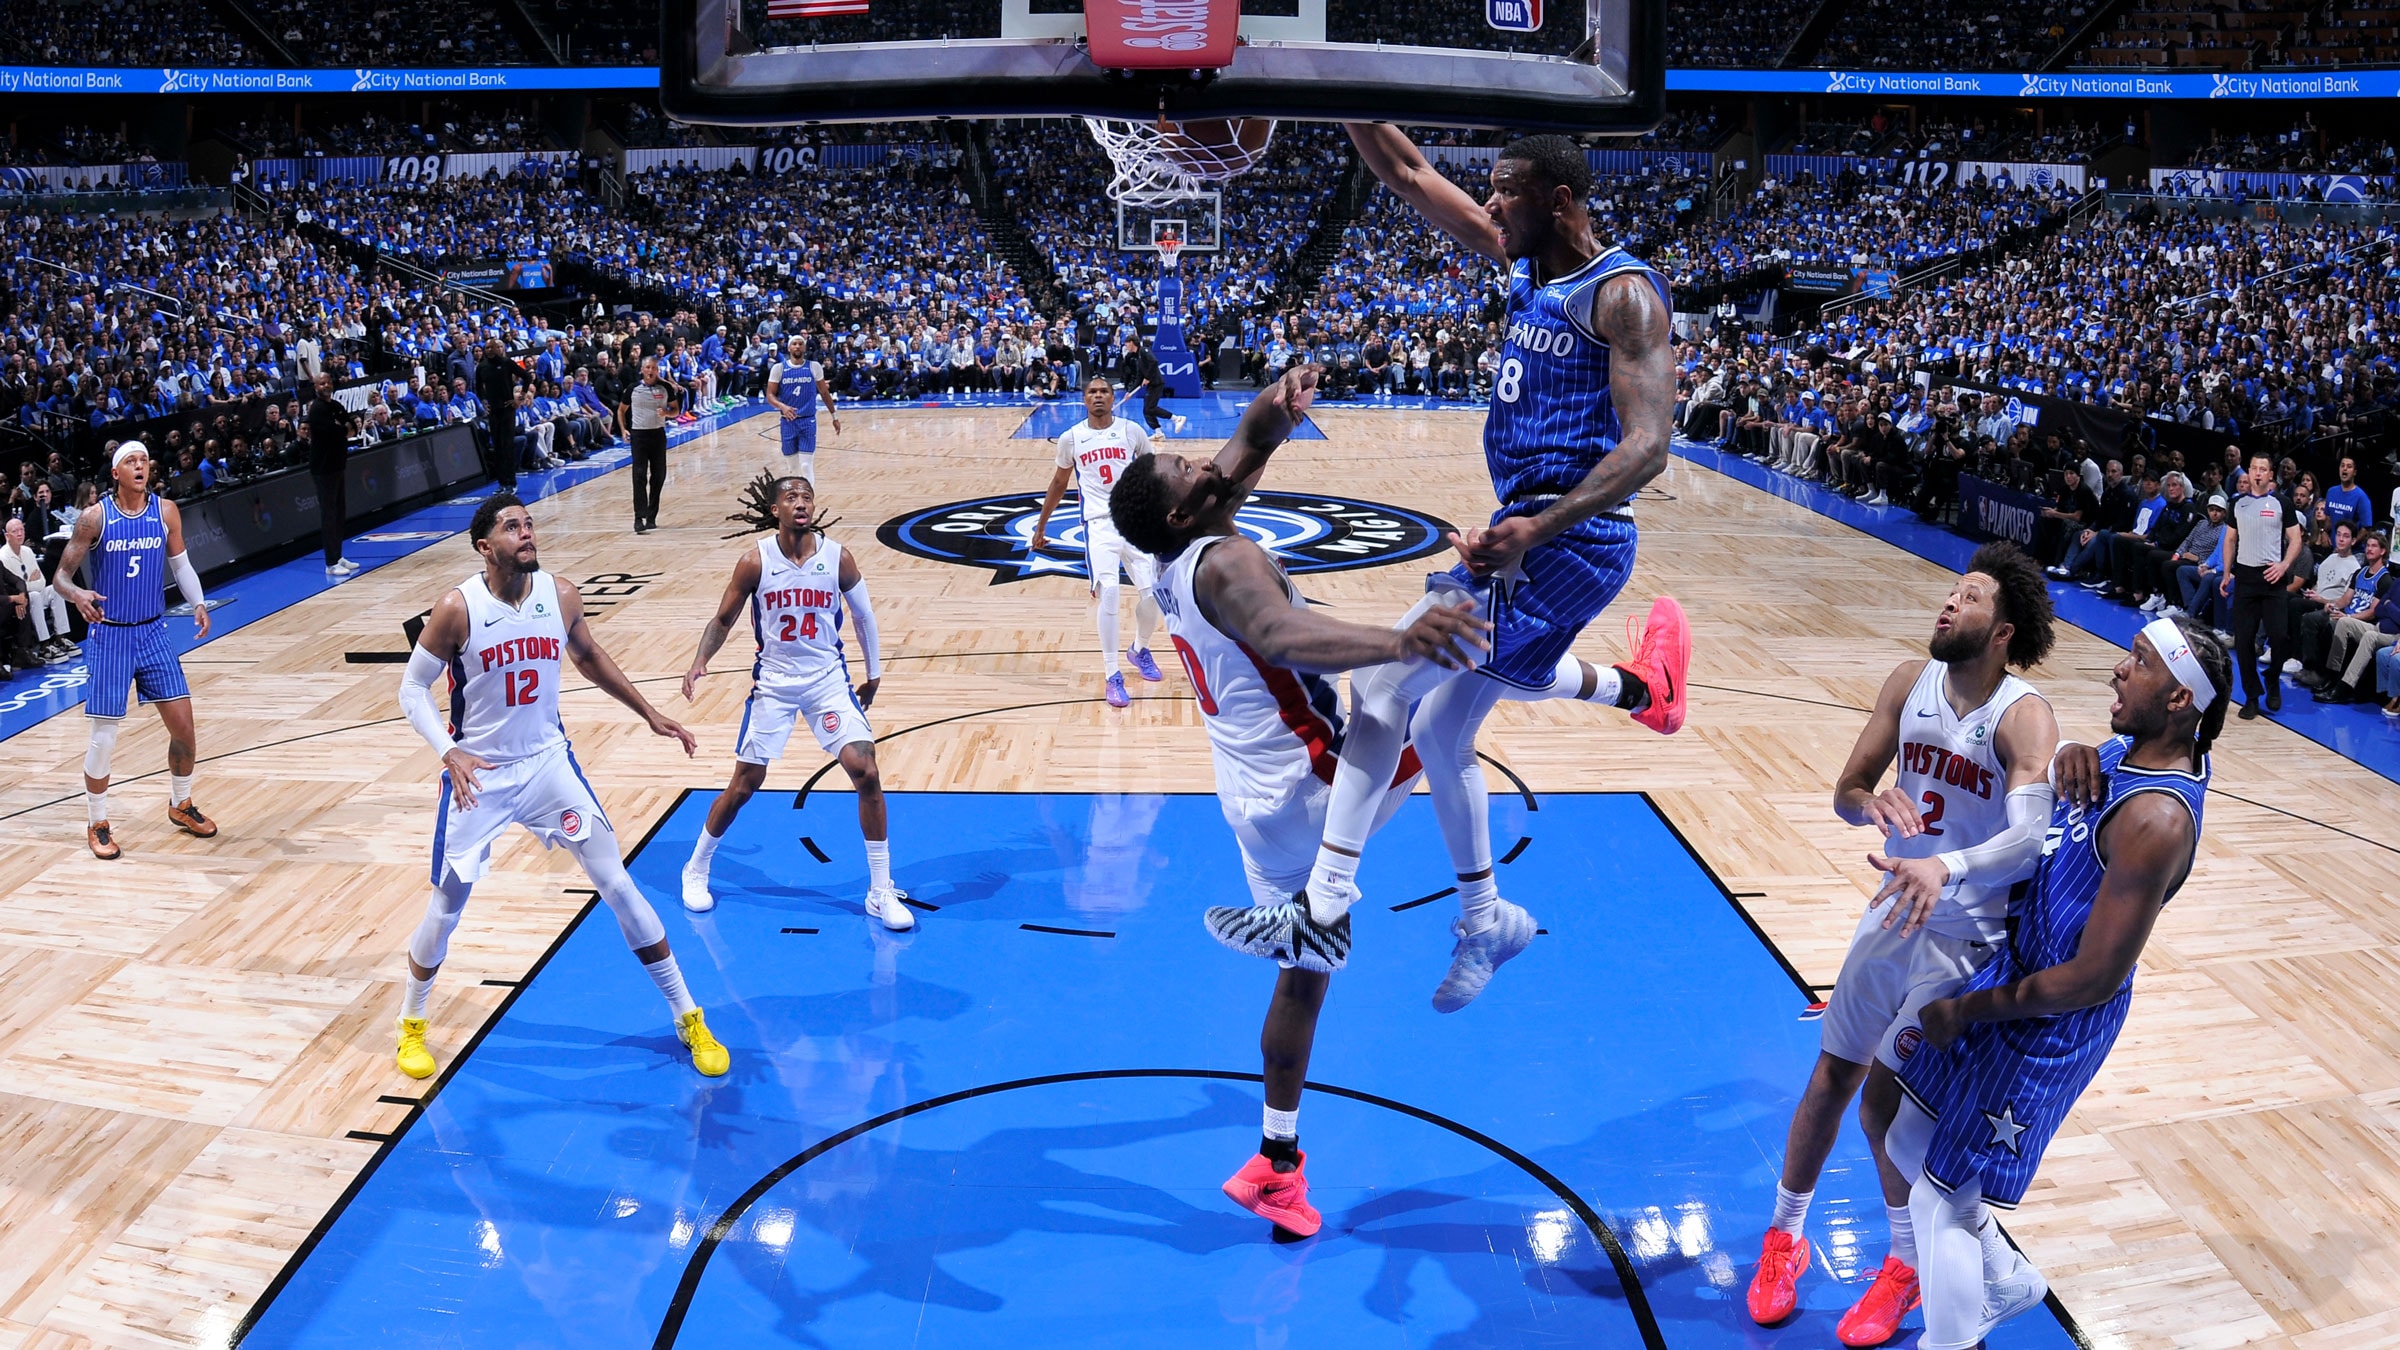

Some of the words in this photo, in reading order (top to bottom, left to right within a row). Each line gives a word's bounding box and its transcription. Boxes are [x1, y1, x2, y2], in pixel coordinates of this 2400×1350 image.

[1495, 1, 1522, 22] NBA
[0, 71, 19, 91] ity
[23, 71, 83, 88] National
[87, 72, 122, 88] Bank
[179, 73, 209, 92] City
[212, 73, 274, 88] National
[277, 74, 312, 88] Bank
[371, 73, 400, 90] City
[404, 72, 466, 87] National
[469, 72, 506, 87] Bank
[1845, 76, 1875, 93] City
[1880, 76, 1941, 91] National
[1944, 77, 1980, 92] Bank
[2038, 78, 2067, 96] City
[2071, 78, 2133, 93] National
[2136, 79, 2173, 94] Bank
[2228, 78, 2257, 97] City
[2262, 77, 2321, 94] National
[2324, 77, 2359, 93] Bank
[388, 155, 440, 184] 108
[1903, 161, 1949, 190] 112
[2255, 206, 2275, 220] 113
[446, 271, 460, 280] City
[461, 269, 488, 278] National
[488, 268, 505, 276] Bank
[1793, 270, 1806, 280] City
[1806, 271, 1832, 279] National
[1832, 272, 1850, 281] Bank
[1163, 297, 1175, 306] GET
[1164, 306, 1175, 315] THE
[1166, 316, 1178, 326] App
[1496, 358, 1523, 403] 8
[792, 386, 801, 397] 4
[1079, 447, 1127, 466] PISTONS
[1099, 464, 1113, 485] 9
[2328, 501, 2354, 513] BALMAIN
[1298, 503, 1406, 554] MAGIC
[1987, 499, 2035, 545] PLAYOFFS
[126, 556, 142, 578] 5
[764, 588, 834, 611] PISTONS
[780, 612, 818, 642] 24
[479, 637, 560, 673] PISTONS
[505, 669, 539, 707] 12
[1903, 742, 1995, 801] PISTONS
[1921, 790, 1945, 837] 2
